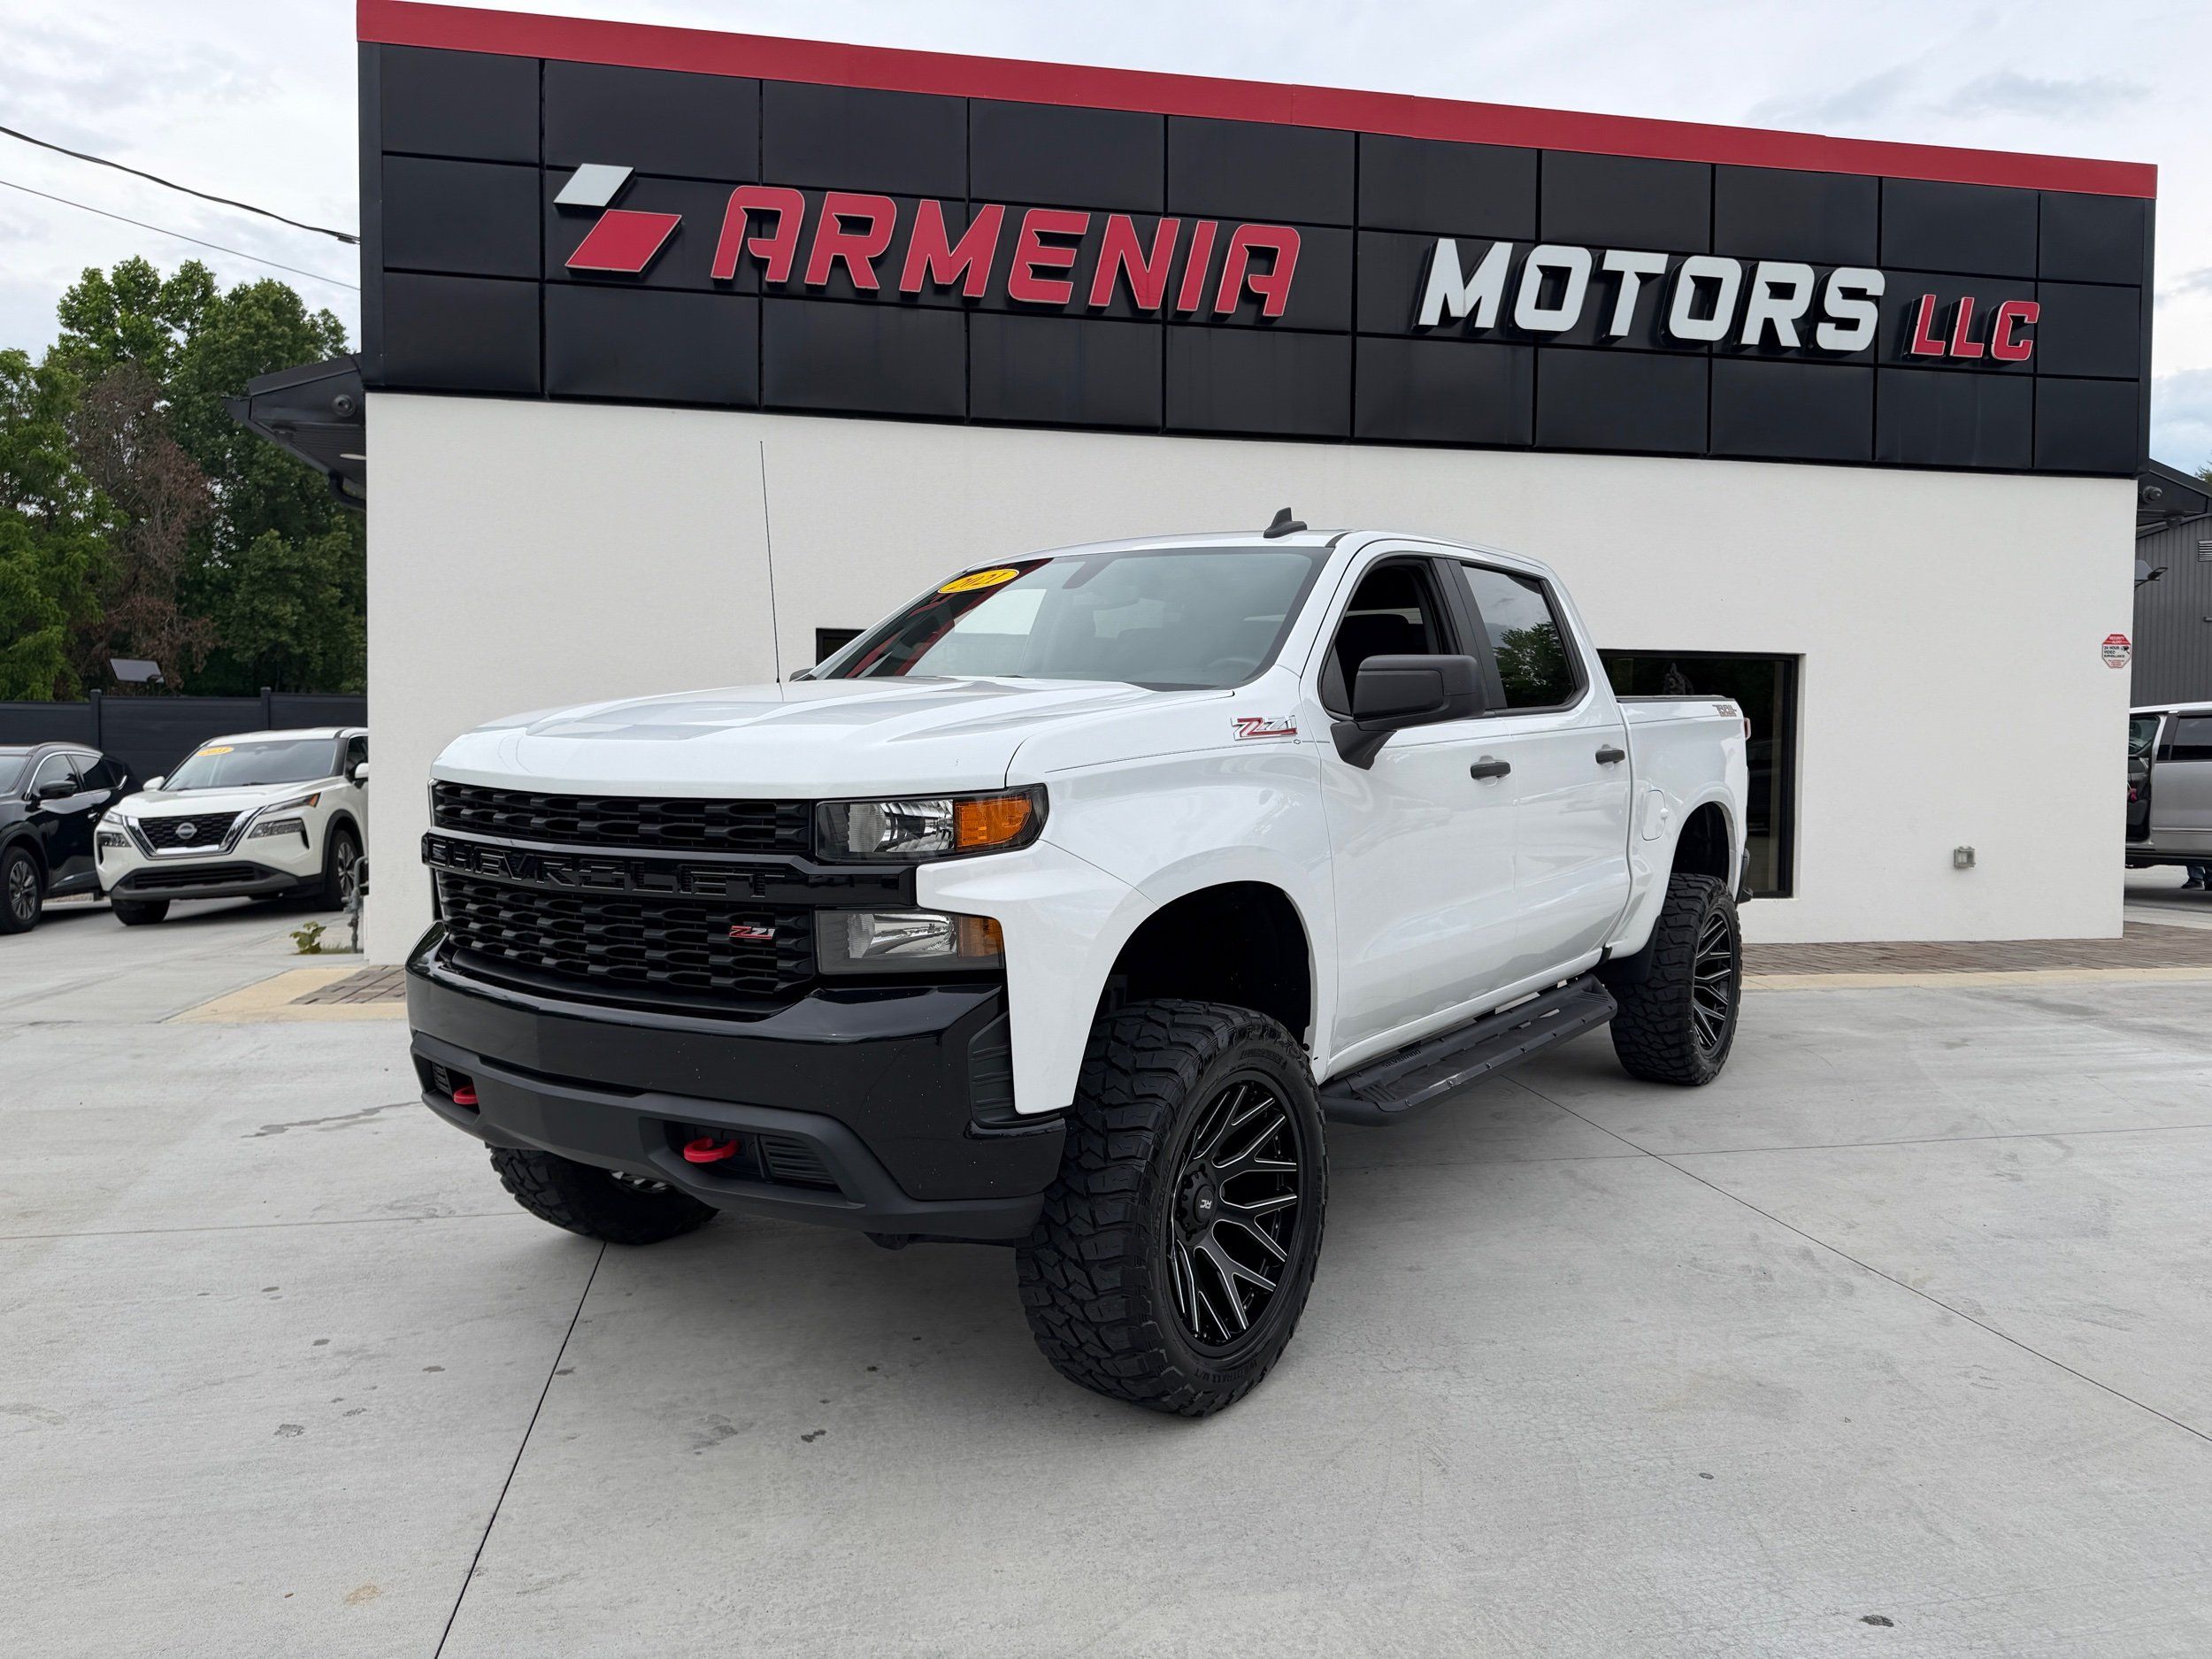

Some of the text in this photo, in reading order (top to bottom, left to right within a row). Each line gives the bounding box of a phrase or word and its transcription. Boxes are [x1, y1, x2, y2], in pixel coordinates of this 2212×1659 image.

[710, 186, 2040, 361] ARMENIA MOTORS LLC
[1231, 715, 1298, 741] Z71
[428, 835, 787, 895] CHEVROLET
[729, 926, 776, 940] Z71
